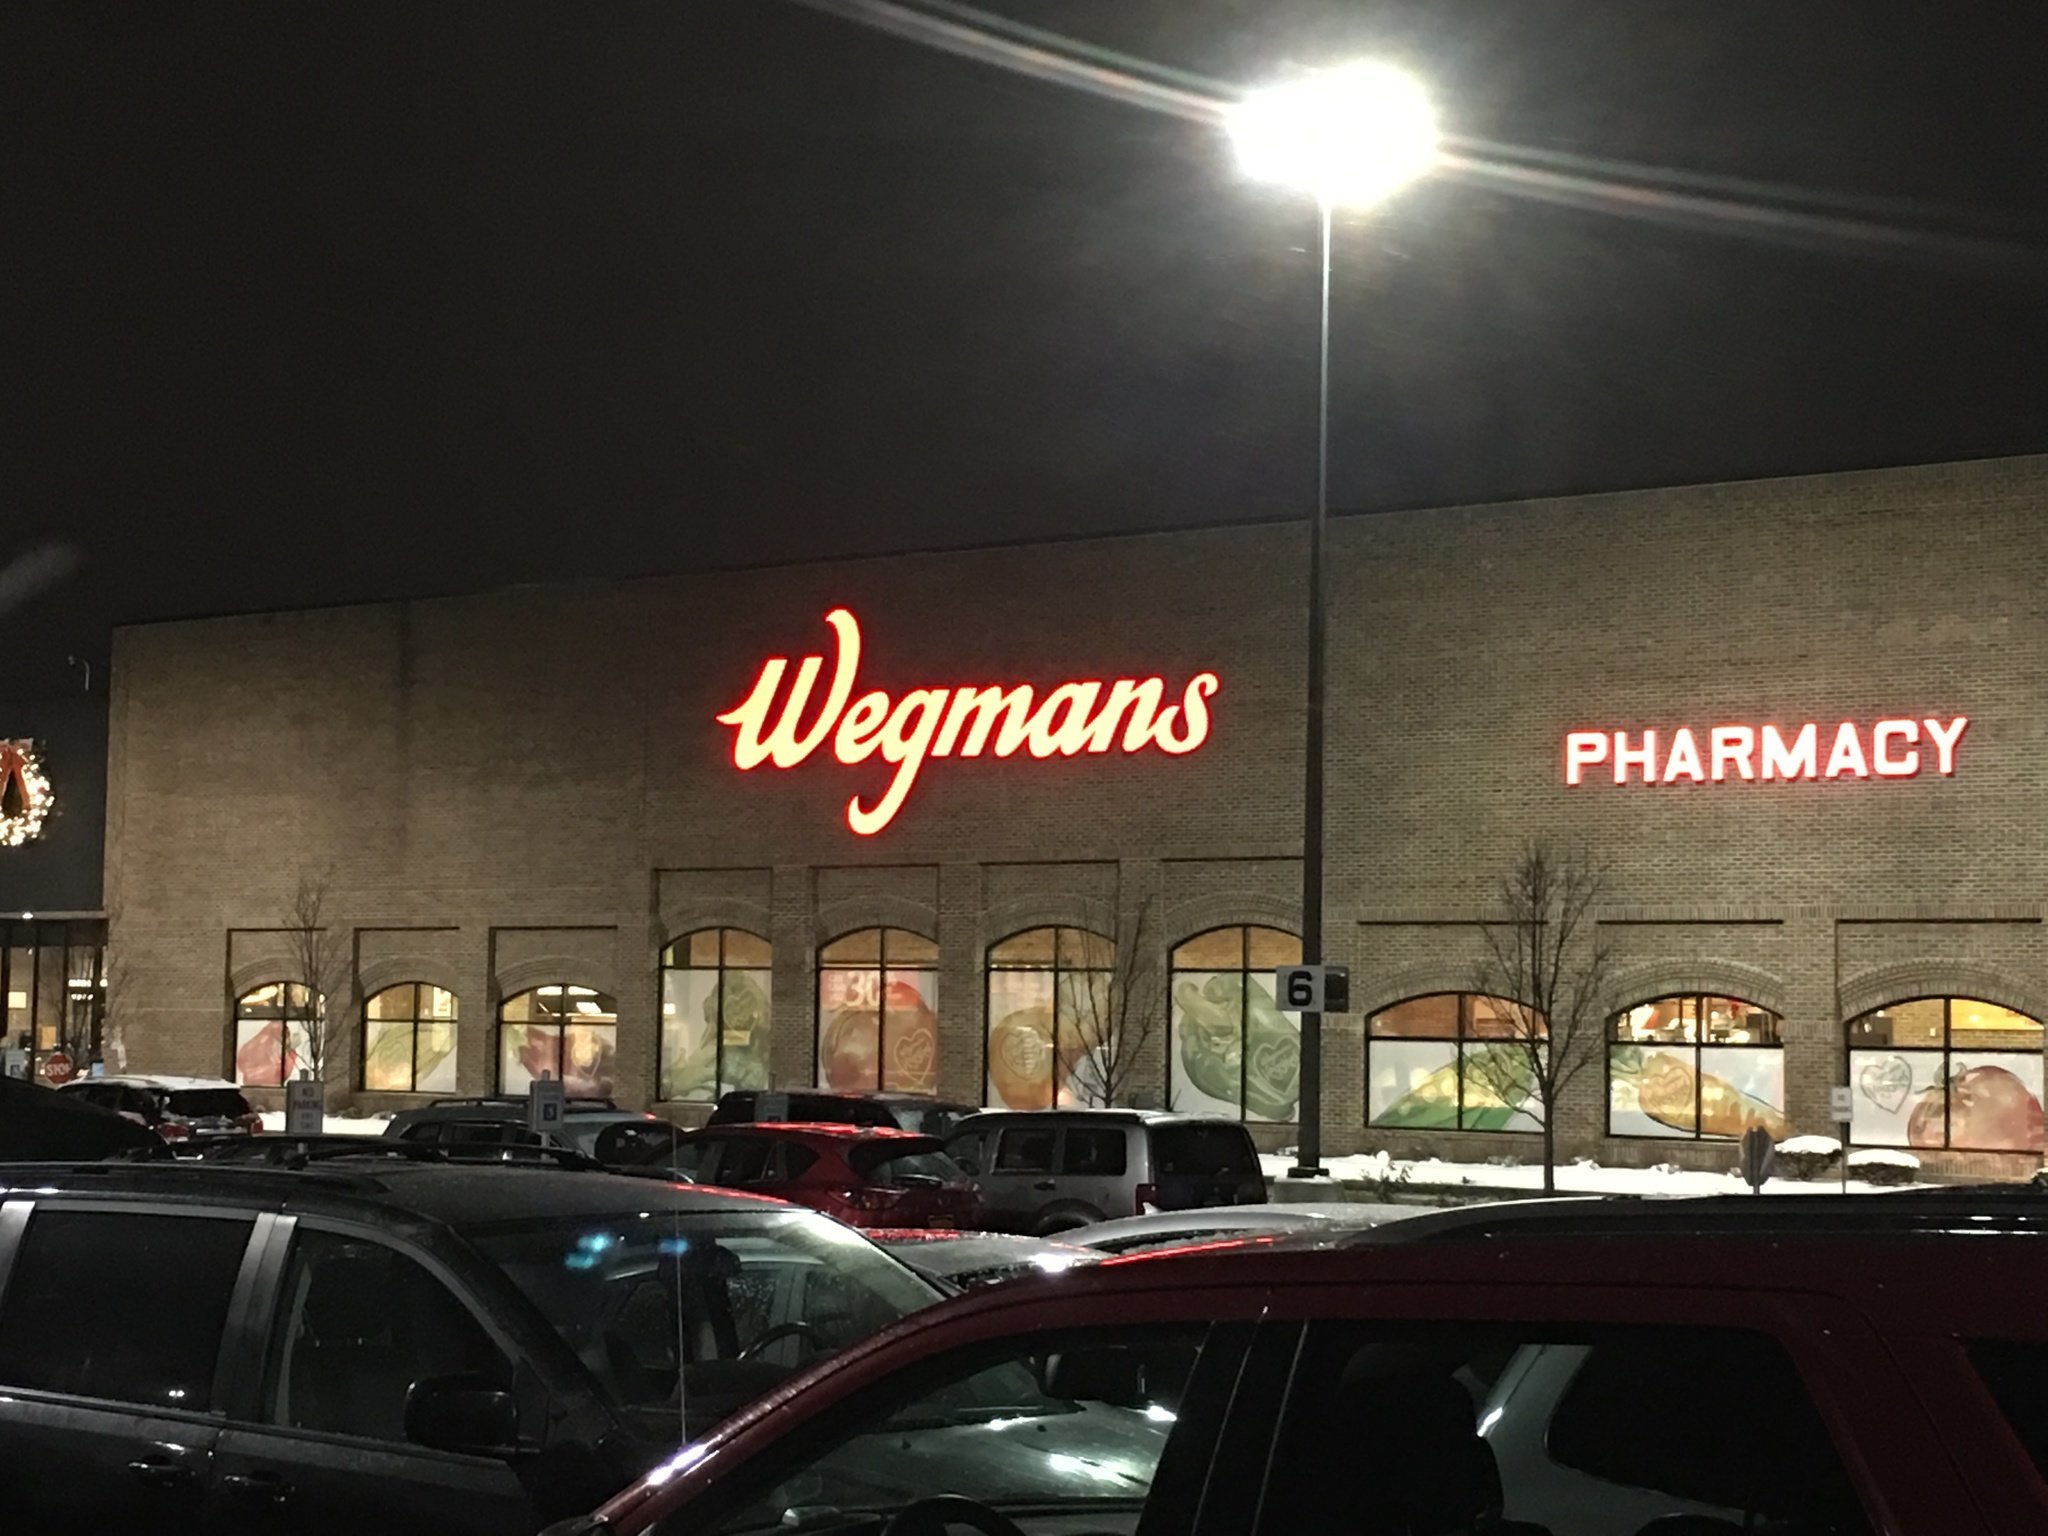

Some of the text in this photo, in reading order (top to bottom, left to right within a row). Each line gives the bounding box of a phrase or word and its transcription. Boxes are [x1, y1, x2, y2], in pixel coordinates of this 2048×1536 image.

[715, 608, 1220, 836] Wegmans
[1565, 716, 1968, 785] PHARMACY
[1288, 970, 1312, 1006] 6
